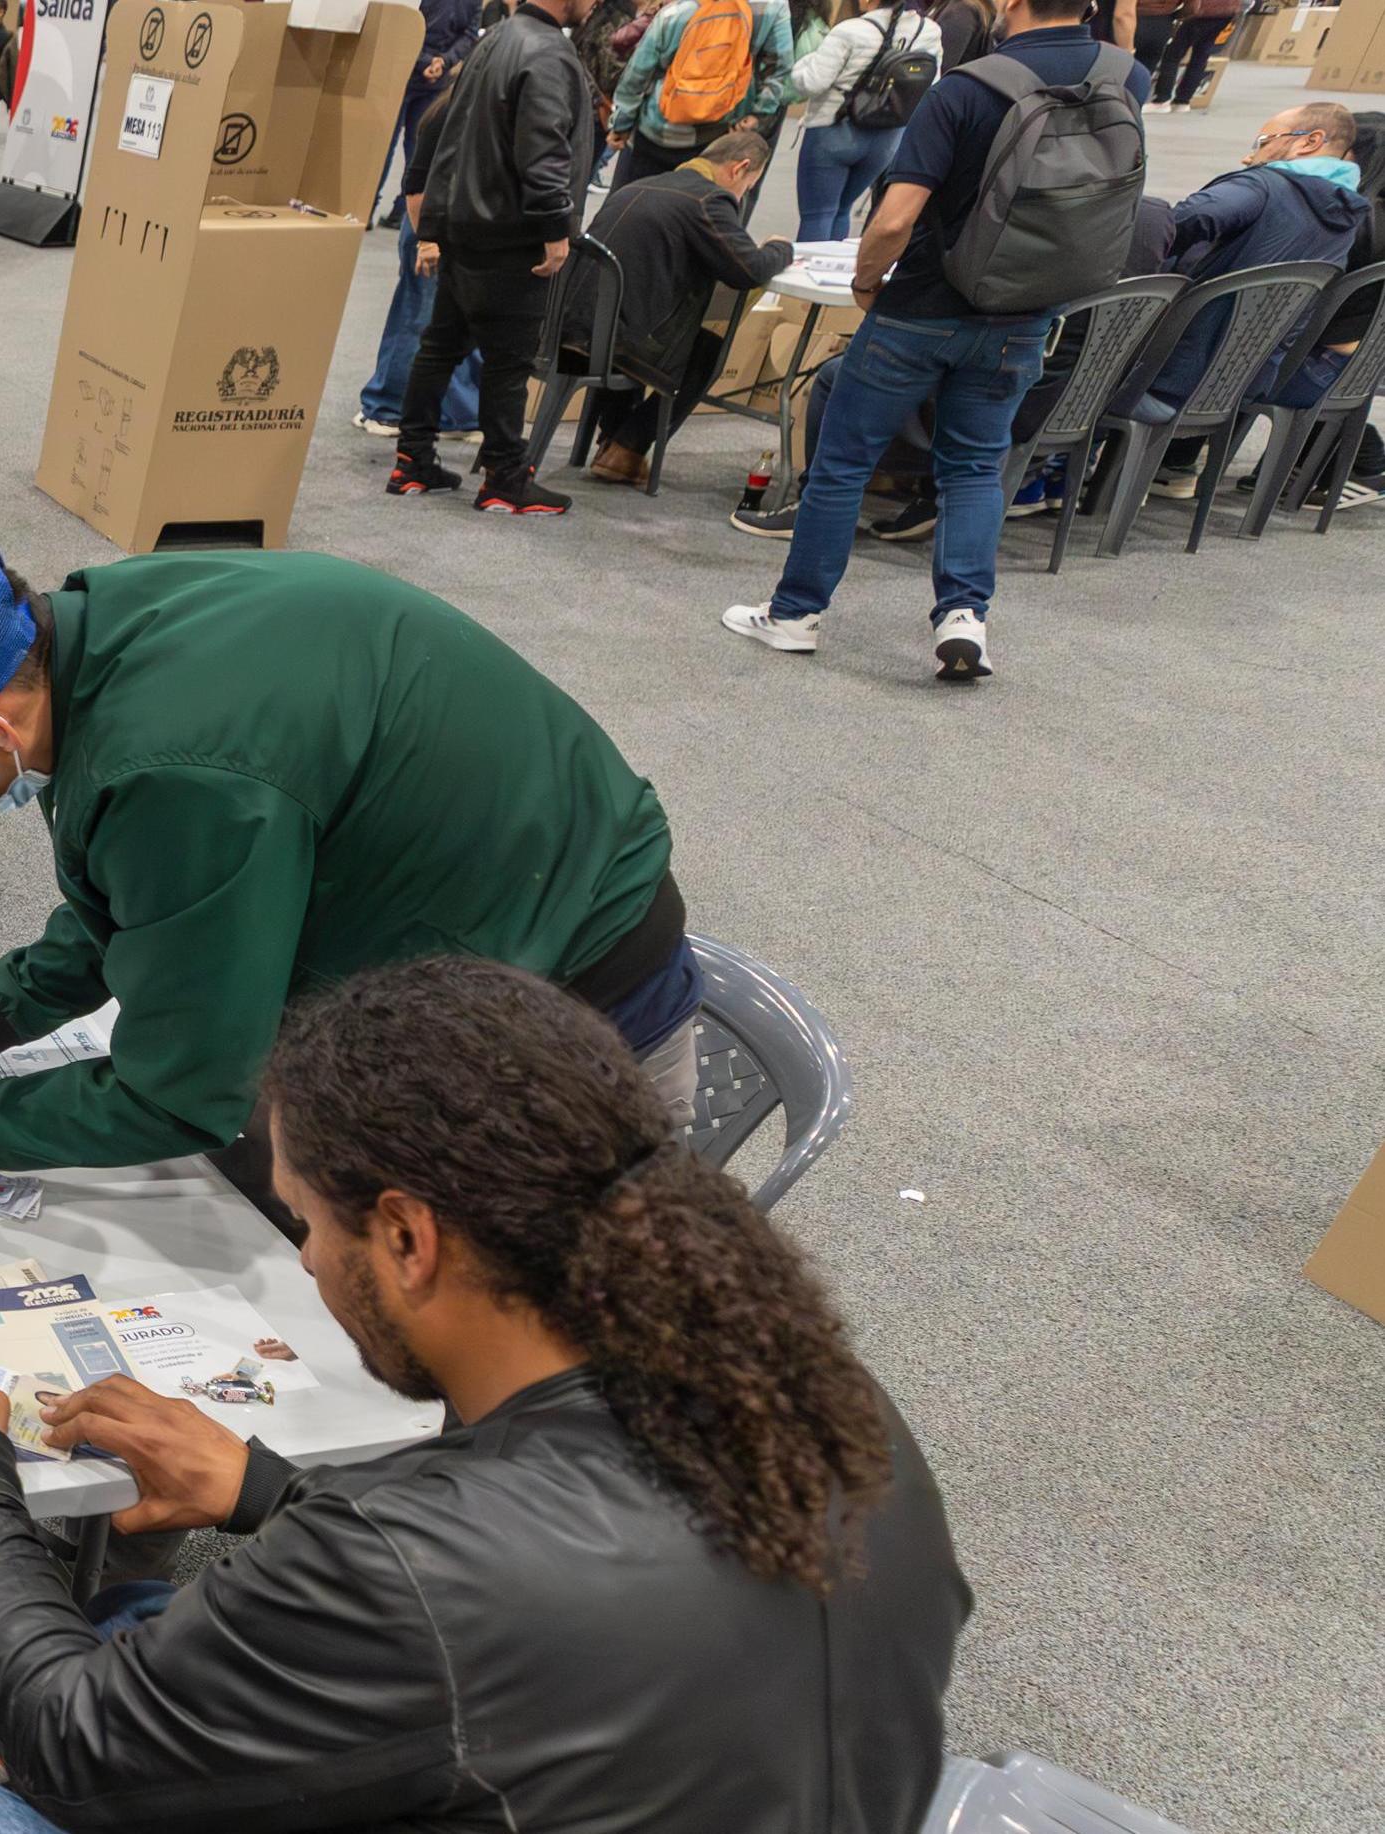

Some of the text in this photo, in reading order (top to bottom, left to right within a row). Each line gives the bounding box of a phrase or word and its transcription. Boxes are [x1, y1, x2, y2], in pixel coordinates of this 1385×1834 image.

[124, 117, 162, 140] MESA 113
[174, 405, 305, 423] REGISTRADURÍA
[172, 421, 302, 432] NACIONAL DEL ESTADO CIVIL
[17, 1283, 81, 1302] 2026
[25, 1292, 81, 1307] ELECCIONES
[108, 1306, 160, 1320] 2026
[115, 1315, 163, 1325] ELECCIONES
[119, 1326, 184, 1343] JURADO
